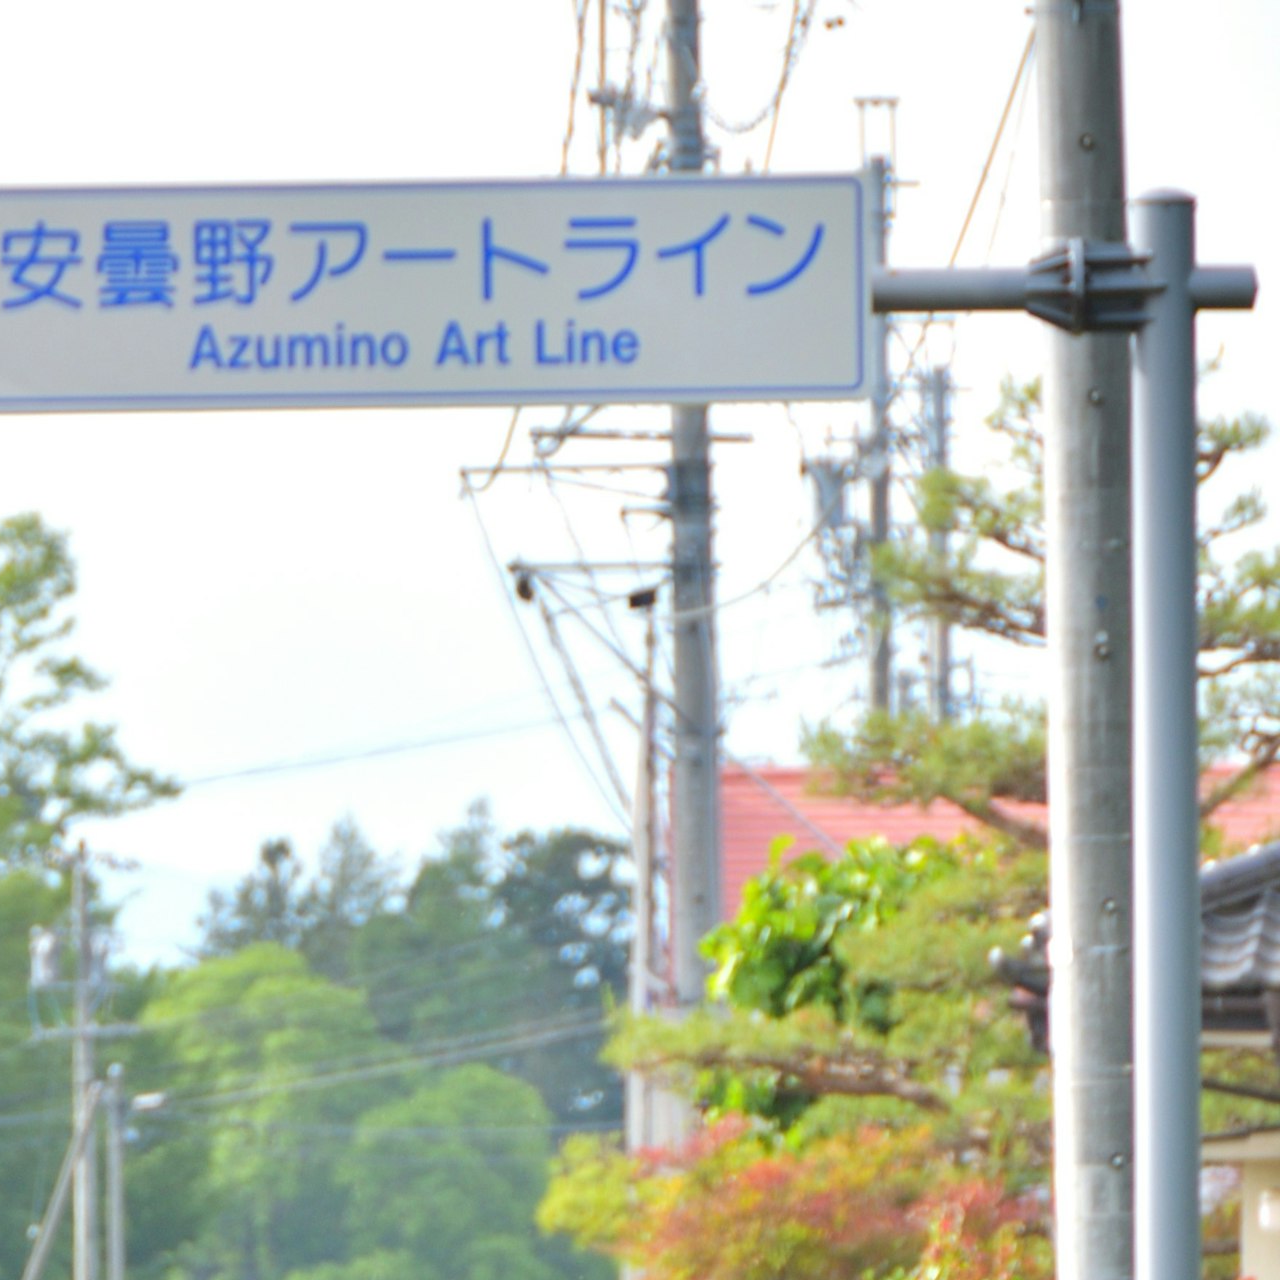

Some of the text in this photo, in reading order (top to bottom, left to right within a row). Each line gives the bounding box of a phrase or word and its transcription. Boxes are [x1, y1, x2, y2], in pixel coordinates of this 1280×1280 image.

[0, 212, 826, 310] 安曇野アートライン
[189, 318, 640, 371] Azumino Art Line
